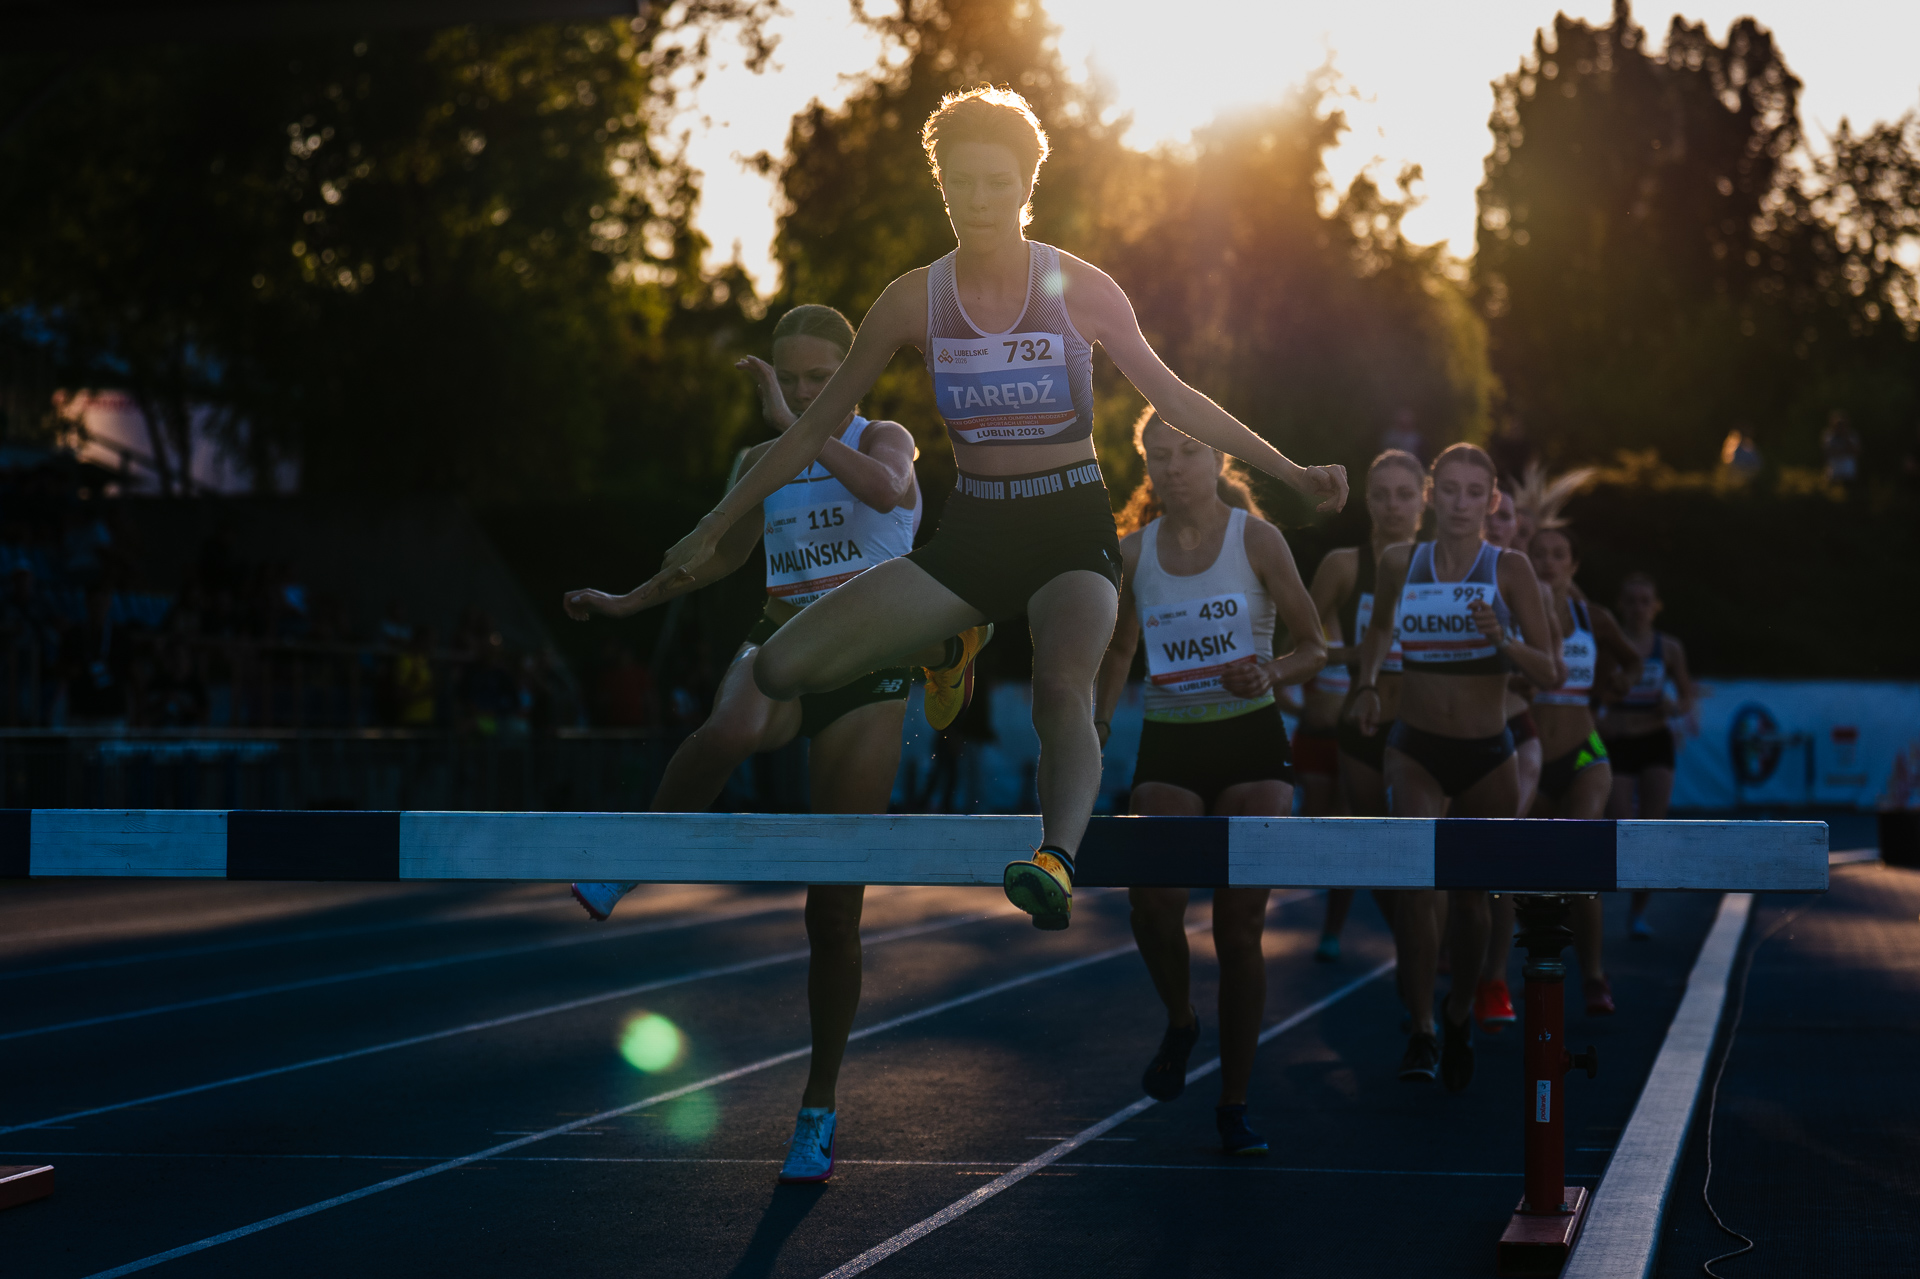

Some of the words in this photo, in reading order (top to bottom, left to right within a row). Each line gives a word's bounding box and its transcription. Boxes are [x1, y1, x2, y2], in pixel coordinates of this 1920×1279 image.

[953, 348, 989, 357] LUBELSKIE
[1002, 339, 1052, 363] 732
[947, 374, 1056, 410] TARĘDŹ
[976, 429, 1015, 438] LUBLIN
[1017, 427, 1045, 436] 2026
[965, 478, 1005, 500] PUMA
[1009, 473, 1064, 500] PUMA
[807, 507, 845, 530] 115
[769, 539, 863, 576] MALIŃSKA
[1453, 586, 1486, 602] 995
[1199, 599, 1238, 621] 430
[1402, 615, 1476, 633] OLENDE
[1162, 631, 1237, 662] WĄSIK
